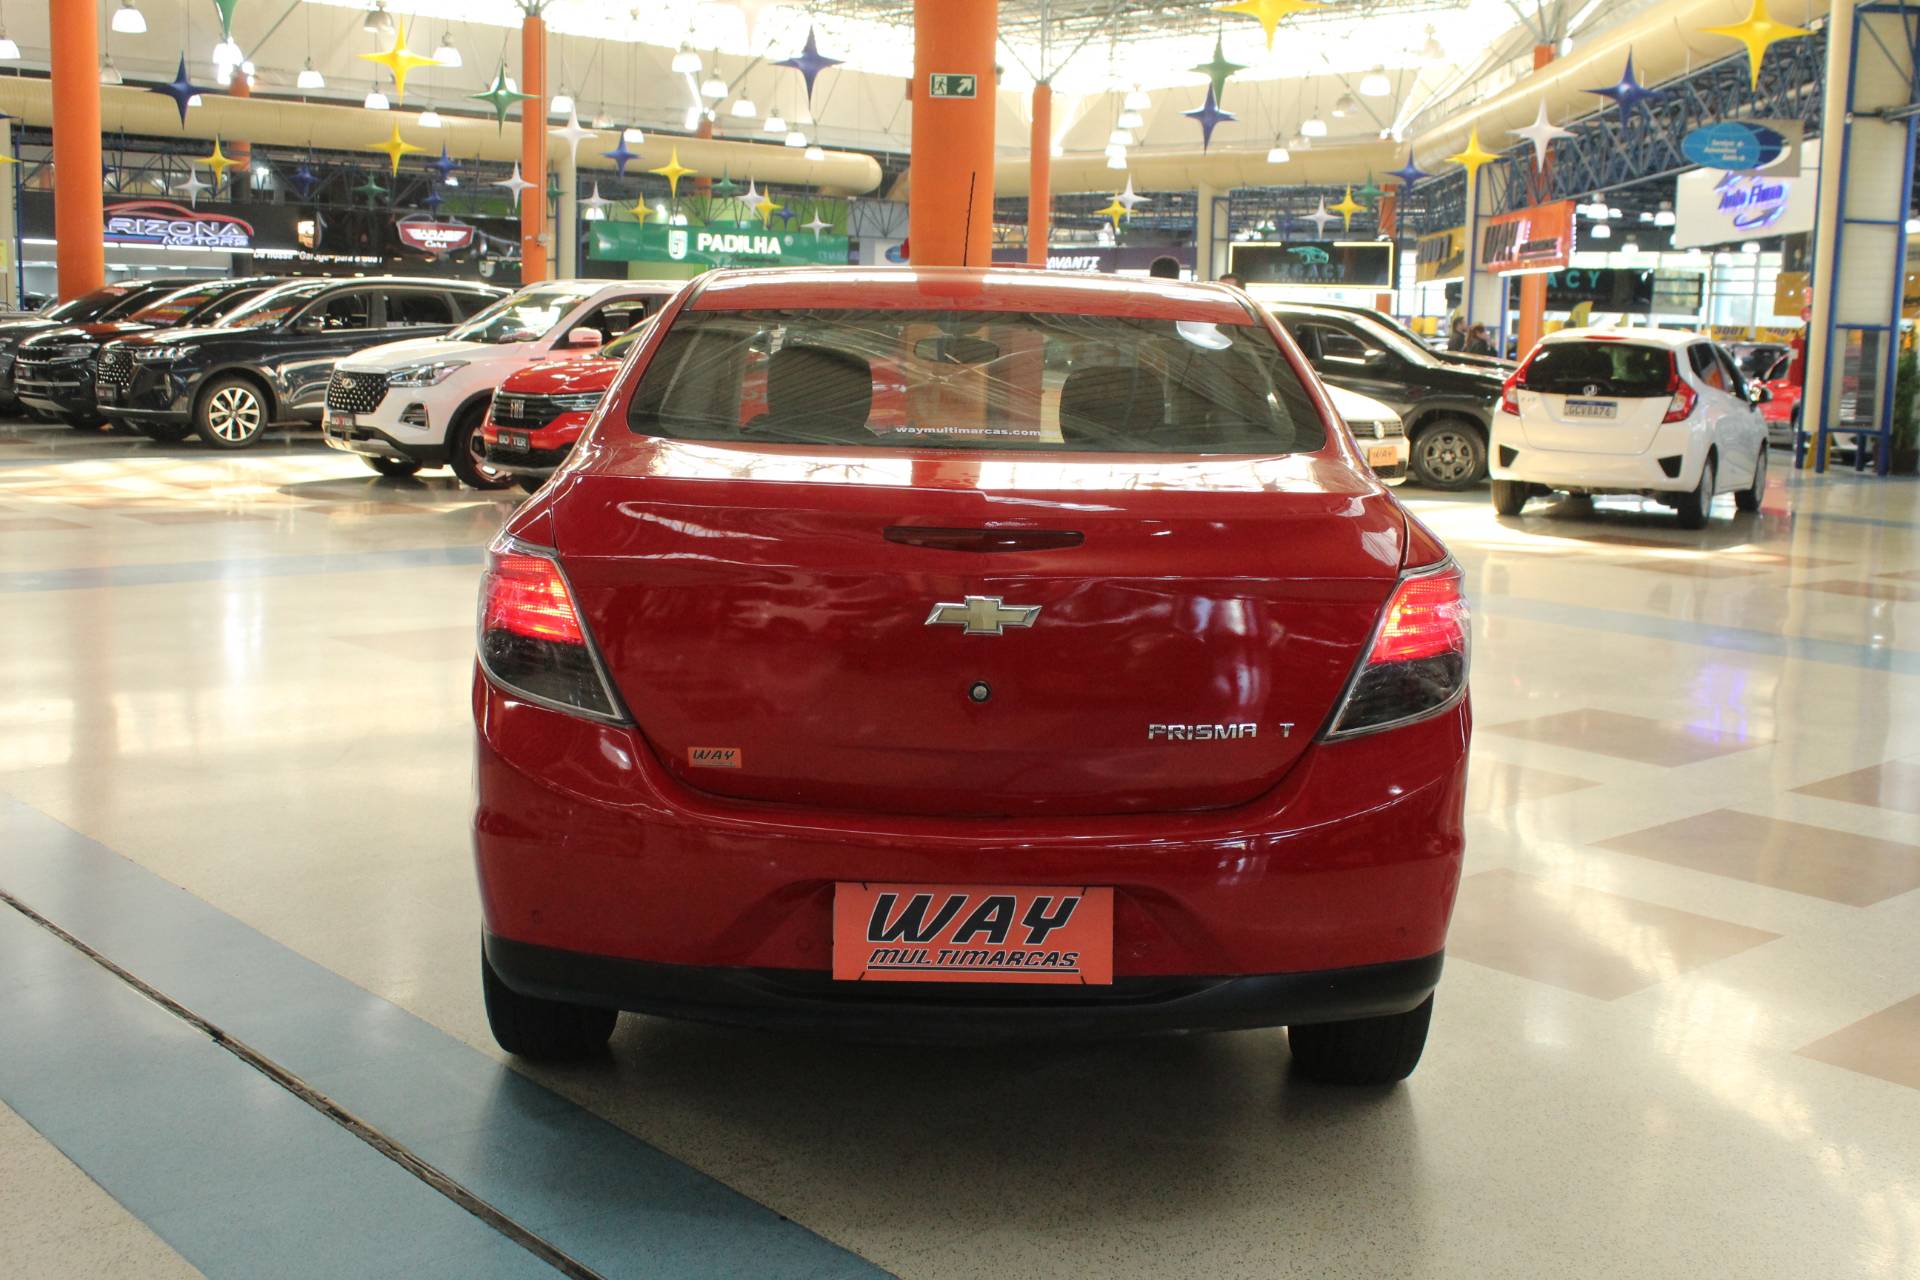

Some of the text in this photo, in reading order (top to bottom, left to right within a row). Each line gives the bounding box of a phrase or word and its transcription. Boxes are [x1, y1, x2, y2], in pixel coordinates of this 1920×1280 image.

[104, 218, 249, 240] RIZONA
[162, 235, 249, 247] MOTORS
[697, 233, 782, 255] PADILHA
[896, 426, 1058, 437] waymultimarcas.com
[1148, 723, 1258, 741] PRISMA
[692, 748, 736, 761] WAY
[866, 892, 1082, 946] WAY
[867, 947, 1081, 968] MULTIMARCAS
